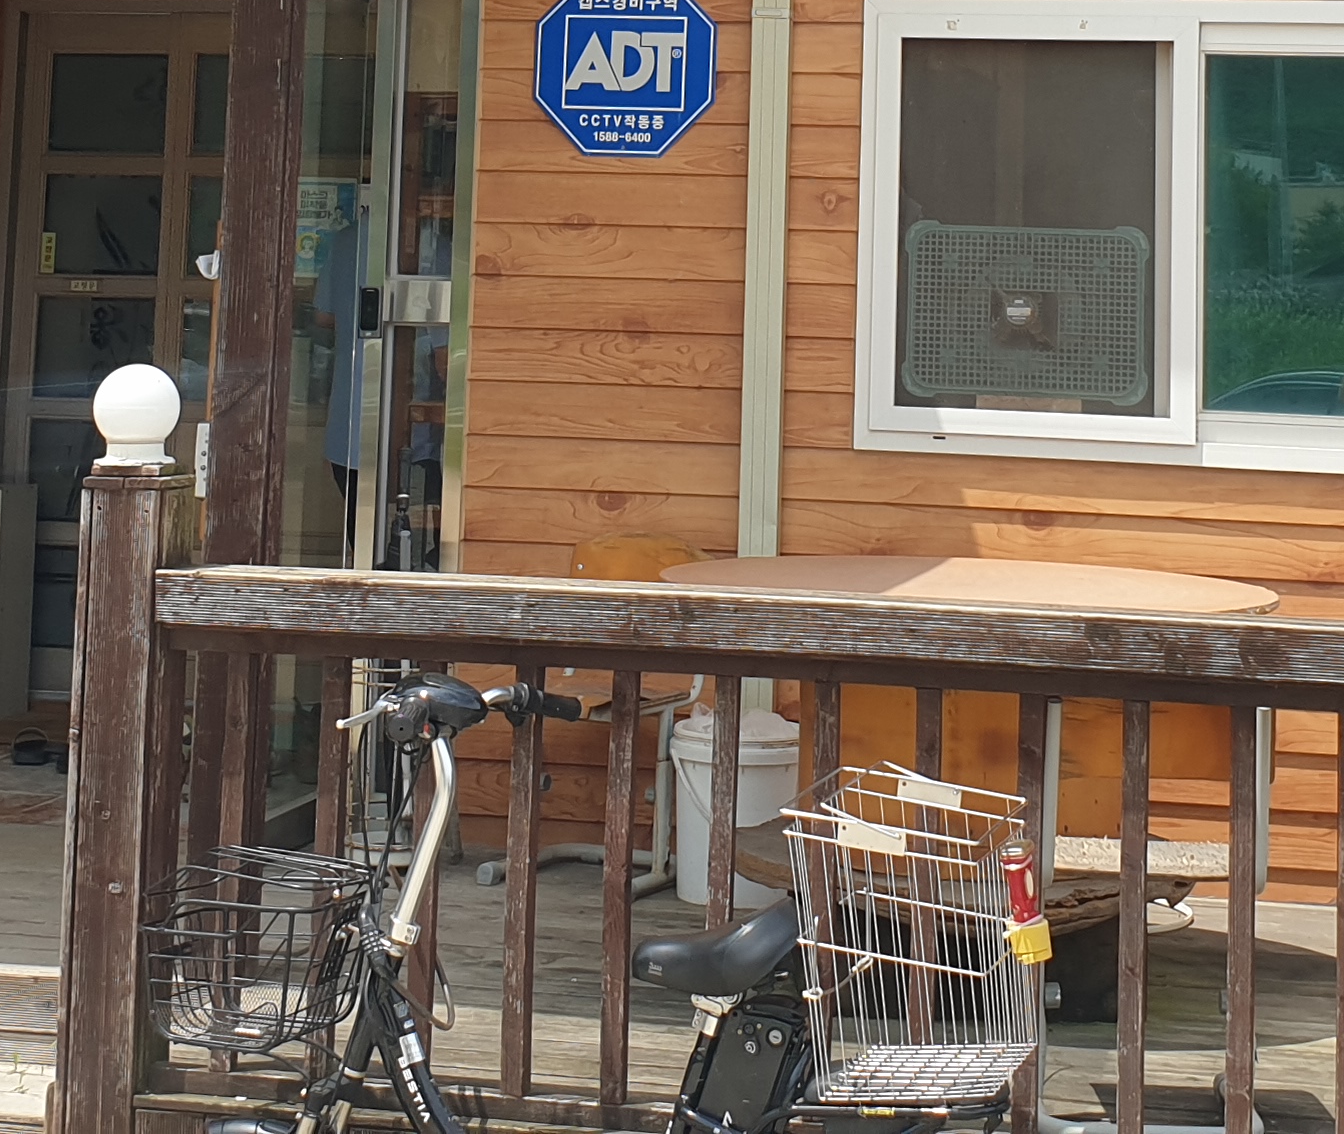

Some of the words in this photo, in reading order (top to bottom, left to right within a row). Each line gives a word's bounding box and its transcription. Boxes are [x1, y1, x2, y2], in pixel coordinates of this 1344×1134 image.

[565, 30, 685, 93] ADT
[579, 114, 665, 129] CCTV작동중
[593, 131, 652, 144] 1588-6400
